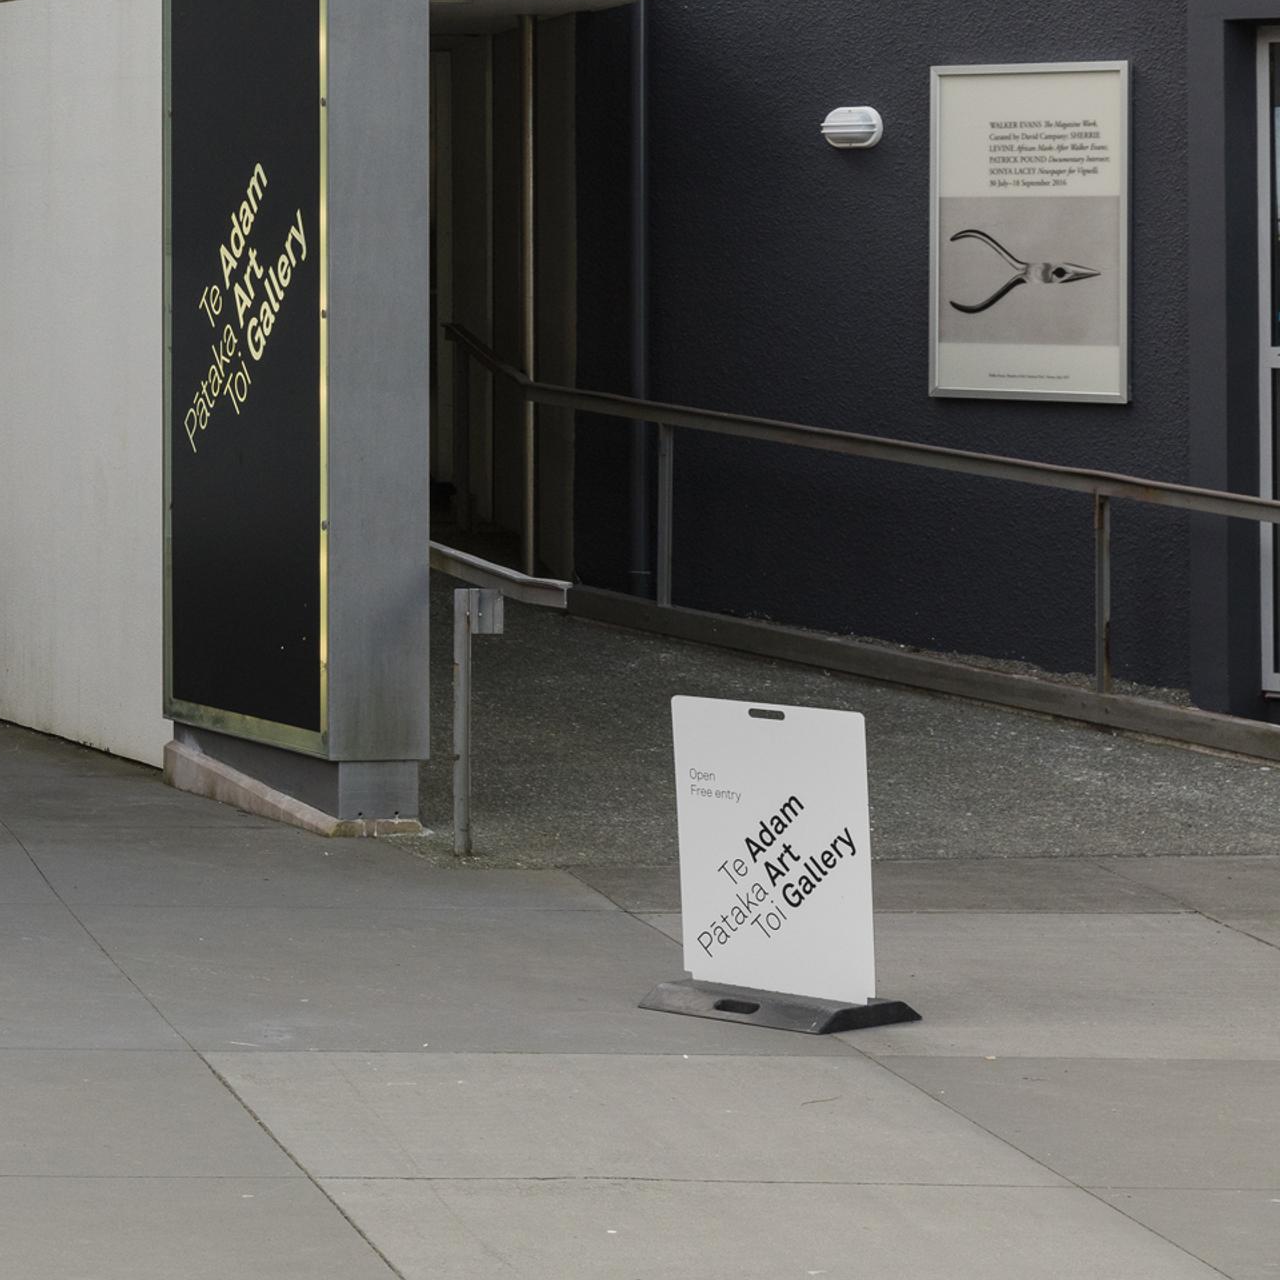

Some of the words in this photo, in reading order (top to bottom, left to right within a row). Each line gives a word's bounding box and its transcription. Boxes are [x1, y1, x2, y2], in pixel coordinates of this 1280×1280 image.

[198, 284, 223, 328] Te
[218, 162, 269, 290] Adam
[183, 323, 239, 454] Pātaka
[233, 247, 265, 329] Art
[223, 351, 252, 416] Toi
[246, 208, 309, 361] Gallery
[689, 768, 716, 783] Open
[690, 784, 713, 799] Free
[714, 786, 742, 804] entry
[717, 857, 749, 885] Te
[744, 795, 805, 864] Adam
[750, 900, 788, 939] Toi
[781, 826, 857, 909] Gallery
[696, 882, 769, 958] Pātaka
[763, 842, 801, 887] Art
